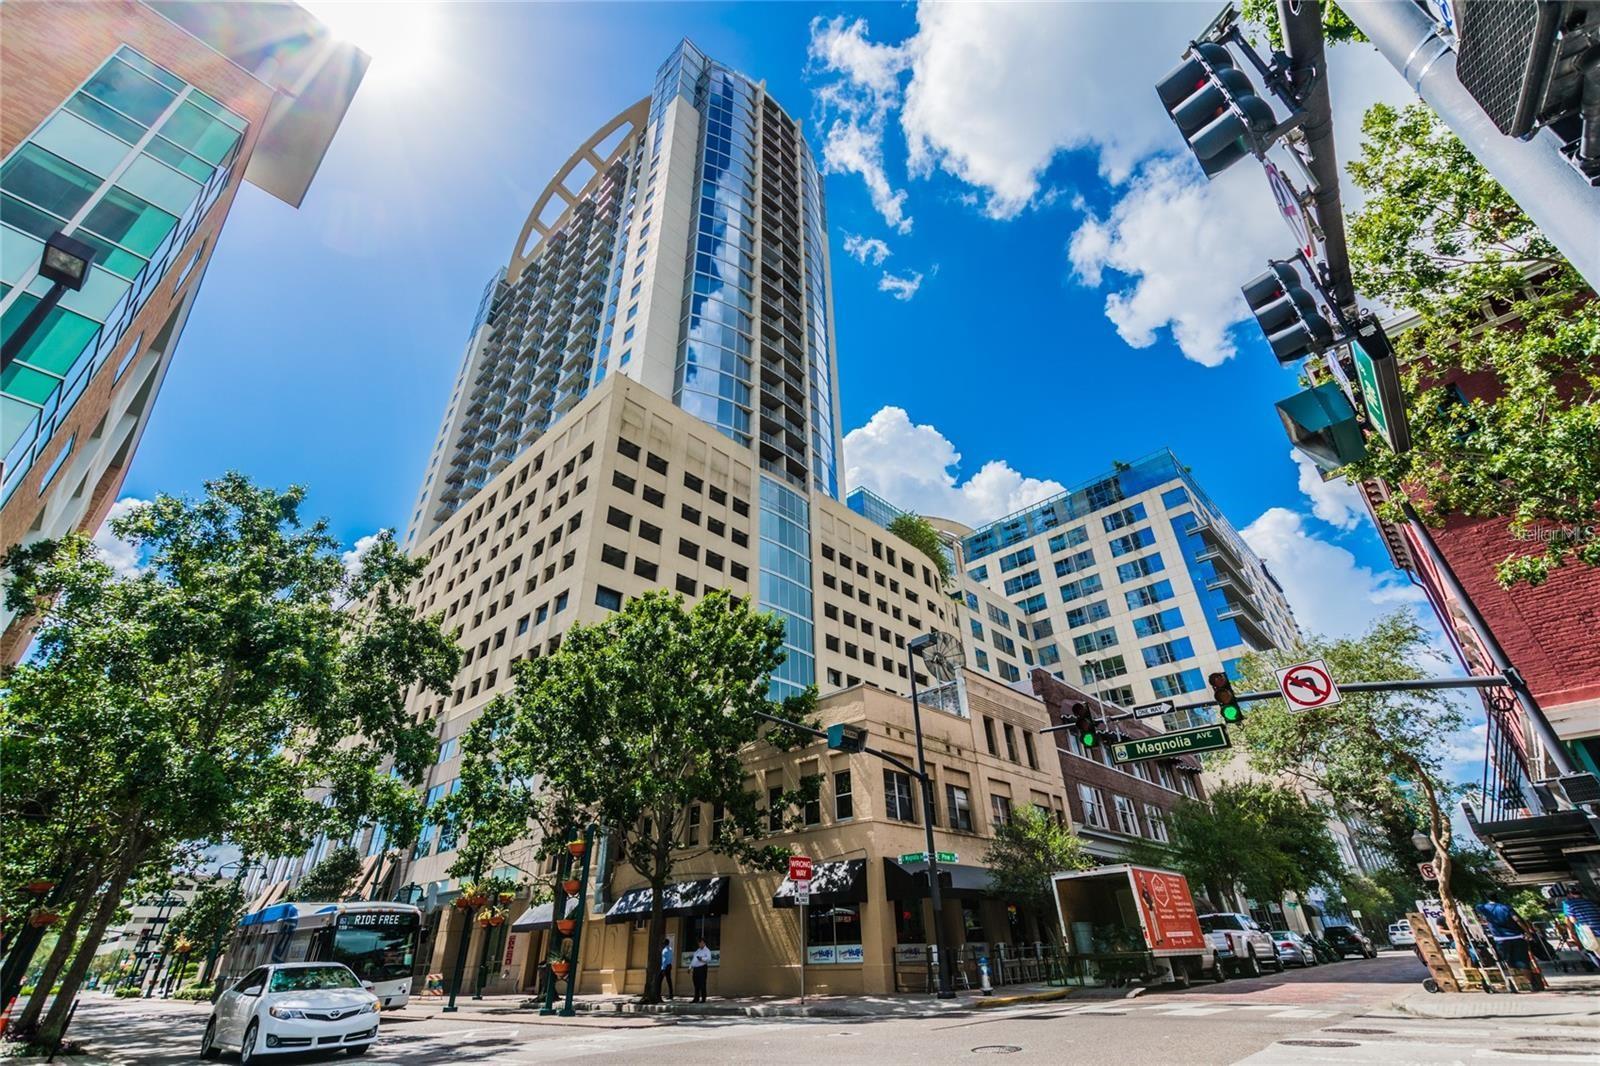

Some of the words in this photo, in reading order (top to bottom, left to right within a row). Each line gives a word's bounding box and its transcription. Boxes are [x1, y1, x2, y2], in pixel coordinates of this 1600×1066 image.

[1137, 707, 1149, 715] ONE
[1150, 705, 1161, 713] WAY
[1136, 736, 1192, 754] Magnolia
[1196, 731, 1213, 740] AVE
[790, 860, 811, 868] WRONG
[795, 869, 807, 877] WAY
[354, 914, 377, 925] RIDE
[378, 914, 400, 925] FREE
